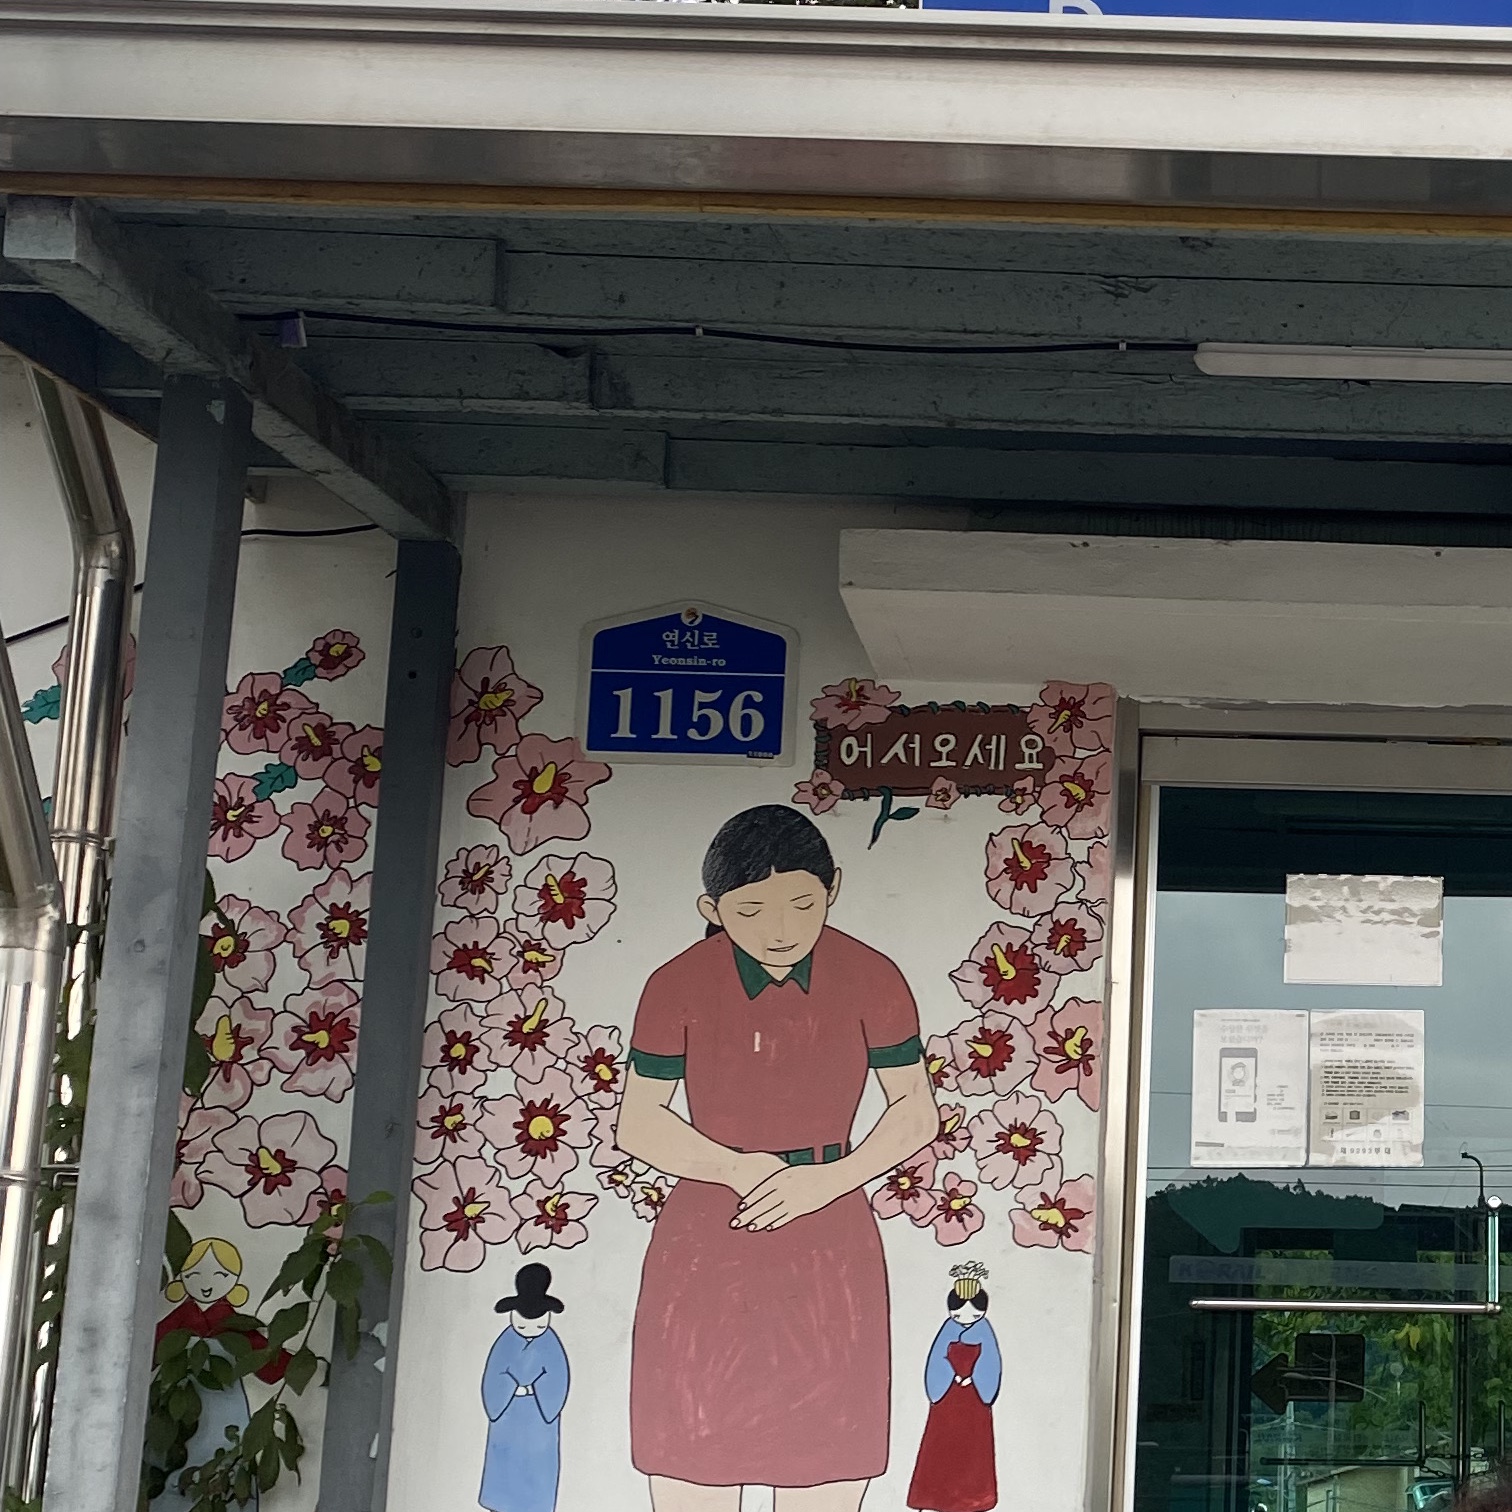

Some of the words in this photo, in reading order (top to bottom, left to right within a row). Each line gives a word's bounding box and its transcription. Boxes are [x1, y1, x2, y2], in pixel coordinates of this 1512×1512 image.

[661, 629, 721, 650] 연신로
[651, 654, 727, 667] Yeonsin-ro
[610, 687, 765, 742] 1156
[839, 733, 1045, 771] 어서오세요
